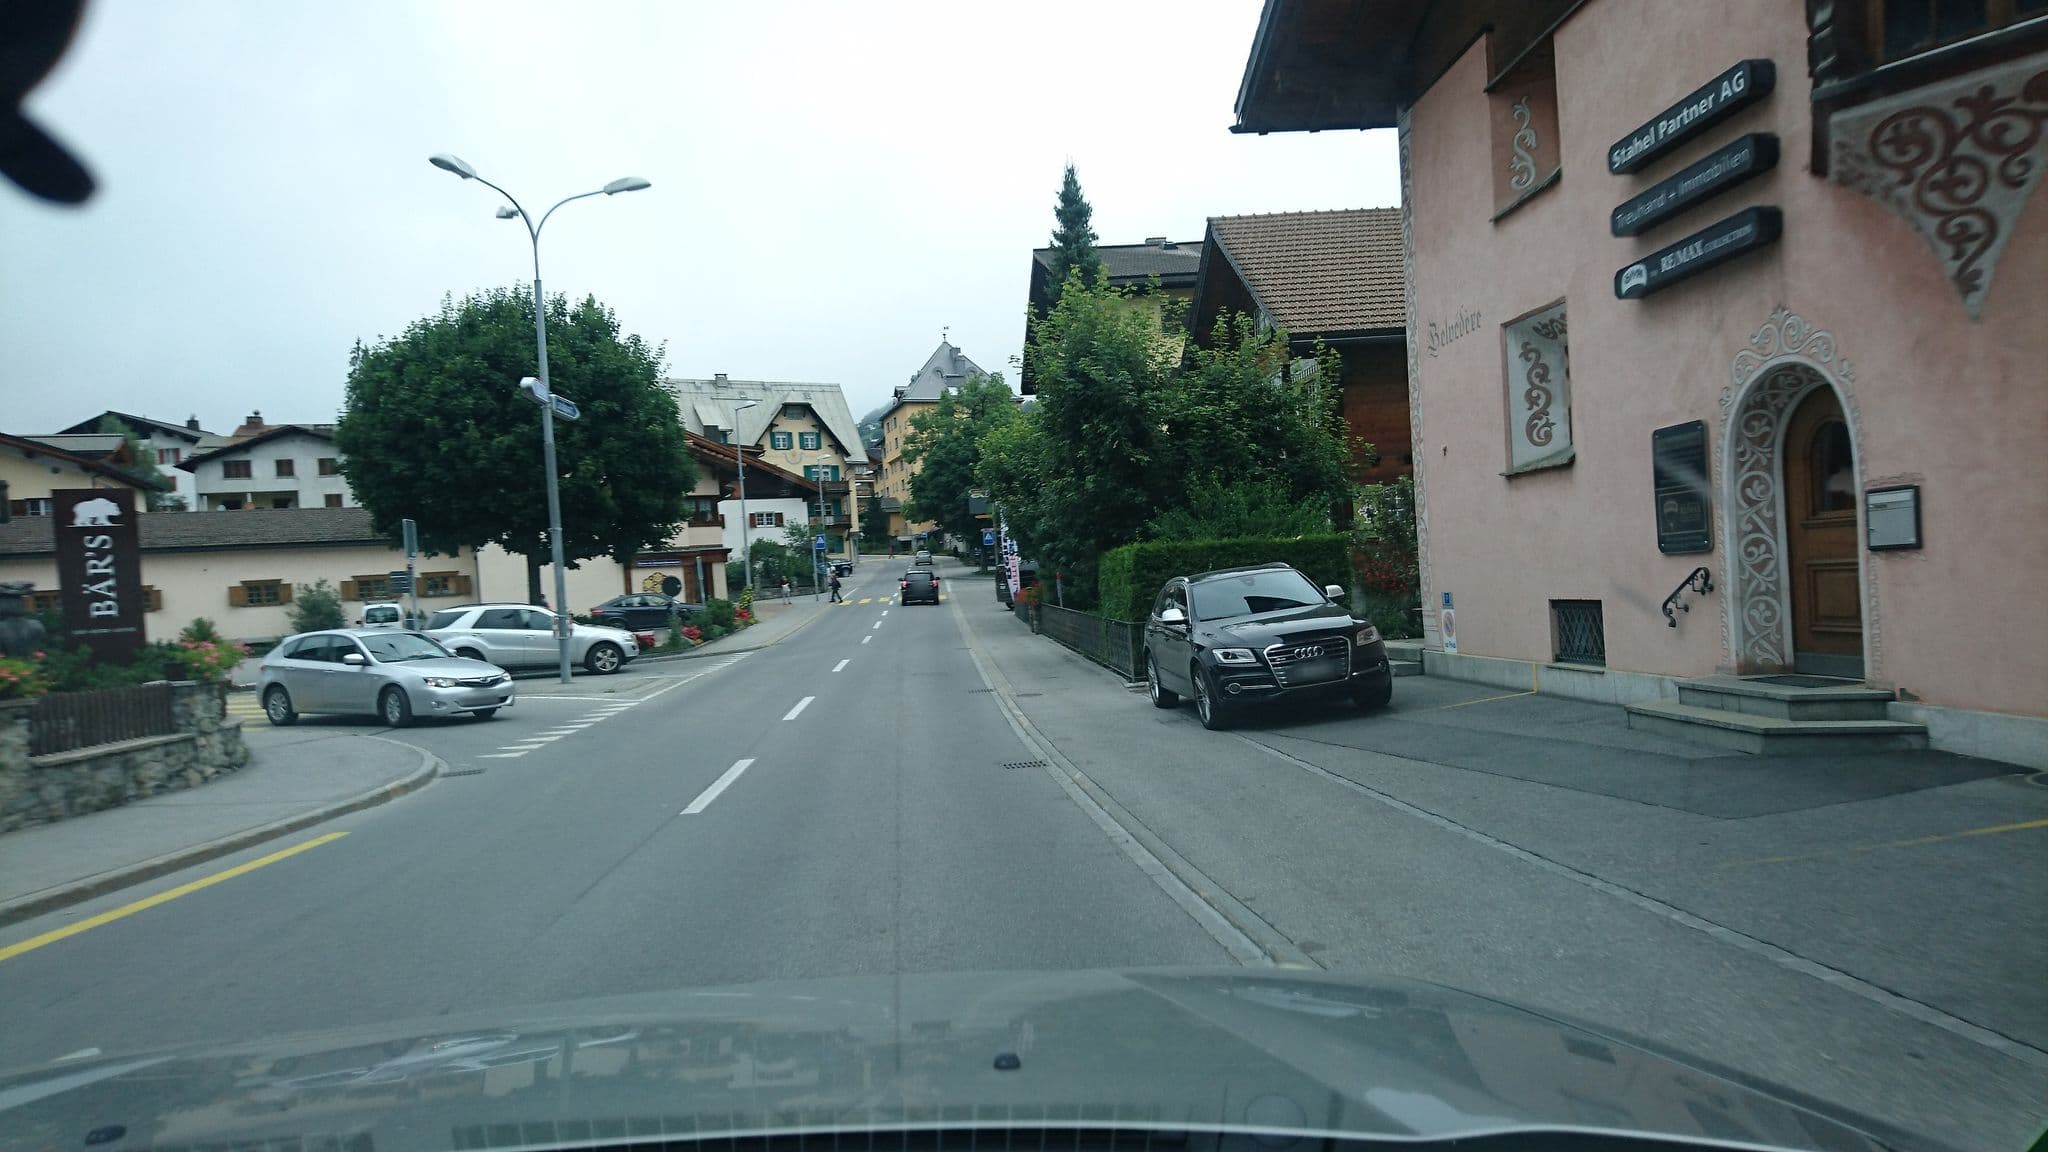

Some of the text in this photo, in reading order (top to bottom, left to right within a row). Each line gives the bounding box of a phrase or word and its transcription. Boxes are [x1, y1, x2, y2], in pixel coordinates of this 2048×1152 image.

[1611, 70, 1745, 170] Stahel Partner AG
[1679, 148, 1750, 195] Immobilien
[81, 534, 119, 618] BÄR'S
